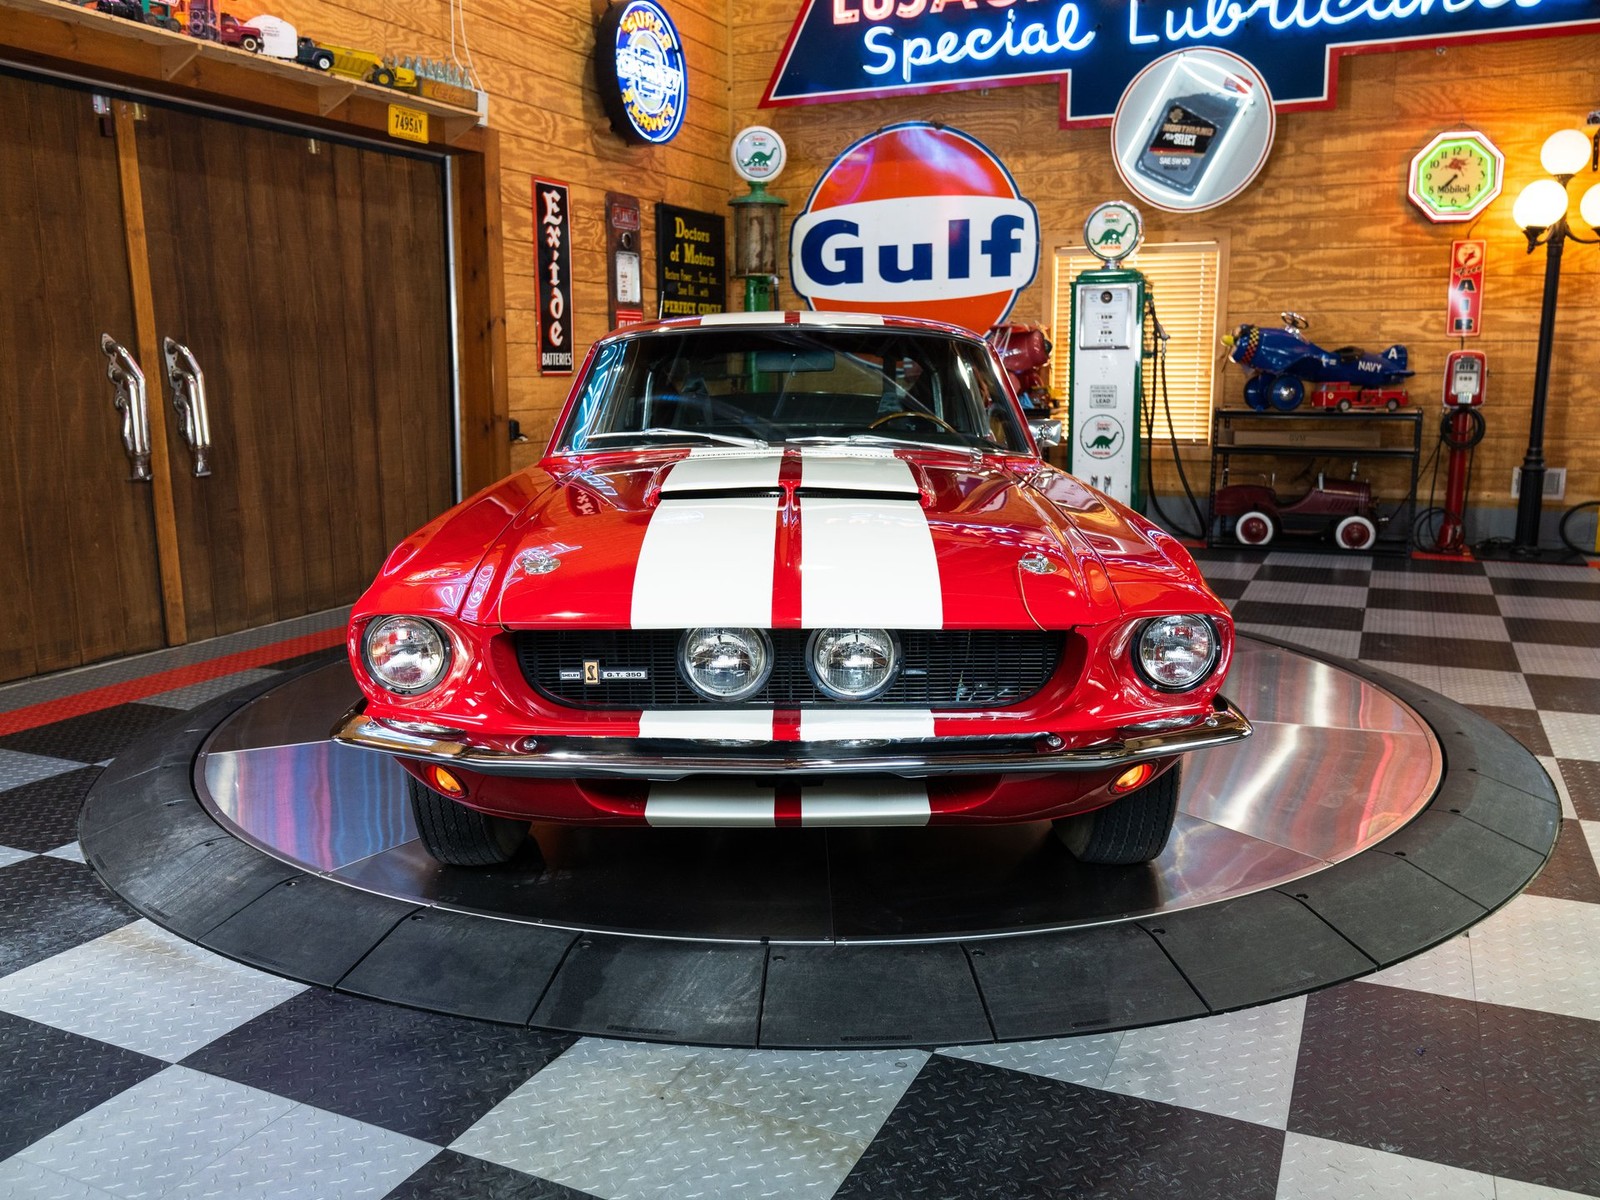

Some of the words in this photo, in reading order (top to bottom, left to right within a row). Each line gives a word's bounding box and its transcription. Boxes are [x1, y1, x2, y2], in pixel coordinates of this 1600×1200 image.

[863, 3, 1096, 82] Special
[1173, 133, 1197, 147] SELECT
[1441, 151, 1448, 159] 11
[1453, 146, 1462, 155] 12
[1430, 160, 1440, 168] 10
[1437, 184, 1470, 193] Mobiloil
[675, 217, 710, 243] Doctors
[670, 244, 680, 262] of
[684, 242, 715, 266] Motors
[801, 214, 1025, 286] Gulf
[543, 189, 564, 347] Exide
[664, 300, 696, 314] PERFECT
[1455, 279, 1476, 331] AIR
[542, 352, 572, 366] BATTERIES
[1387, 347, 1398, 360] A
[1358, 360, 1383, 373] NAVY
